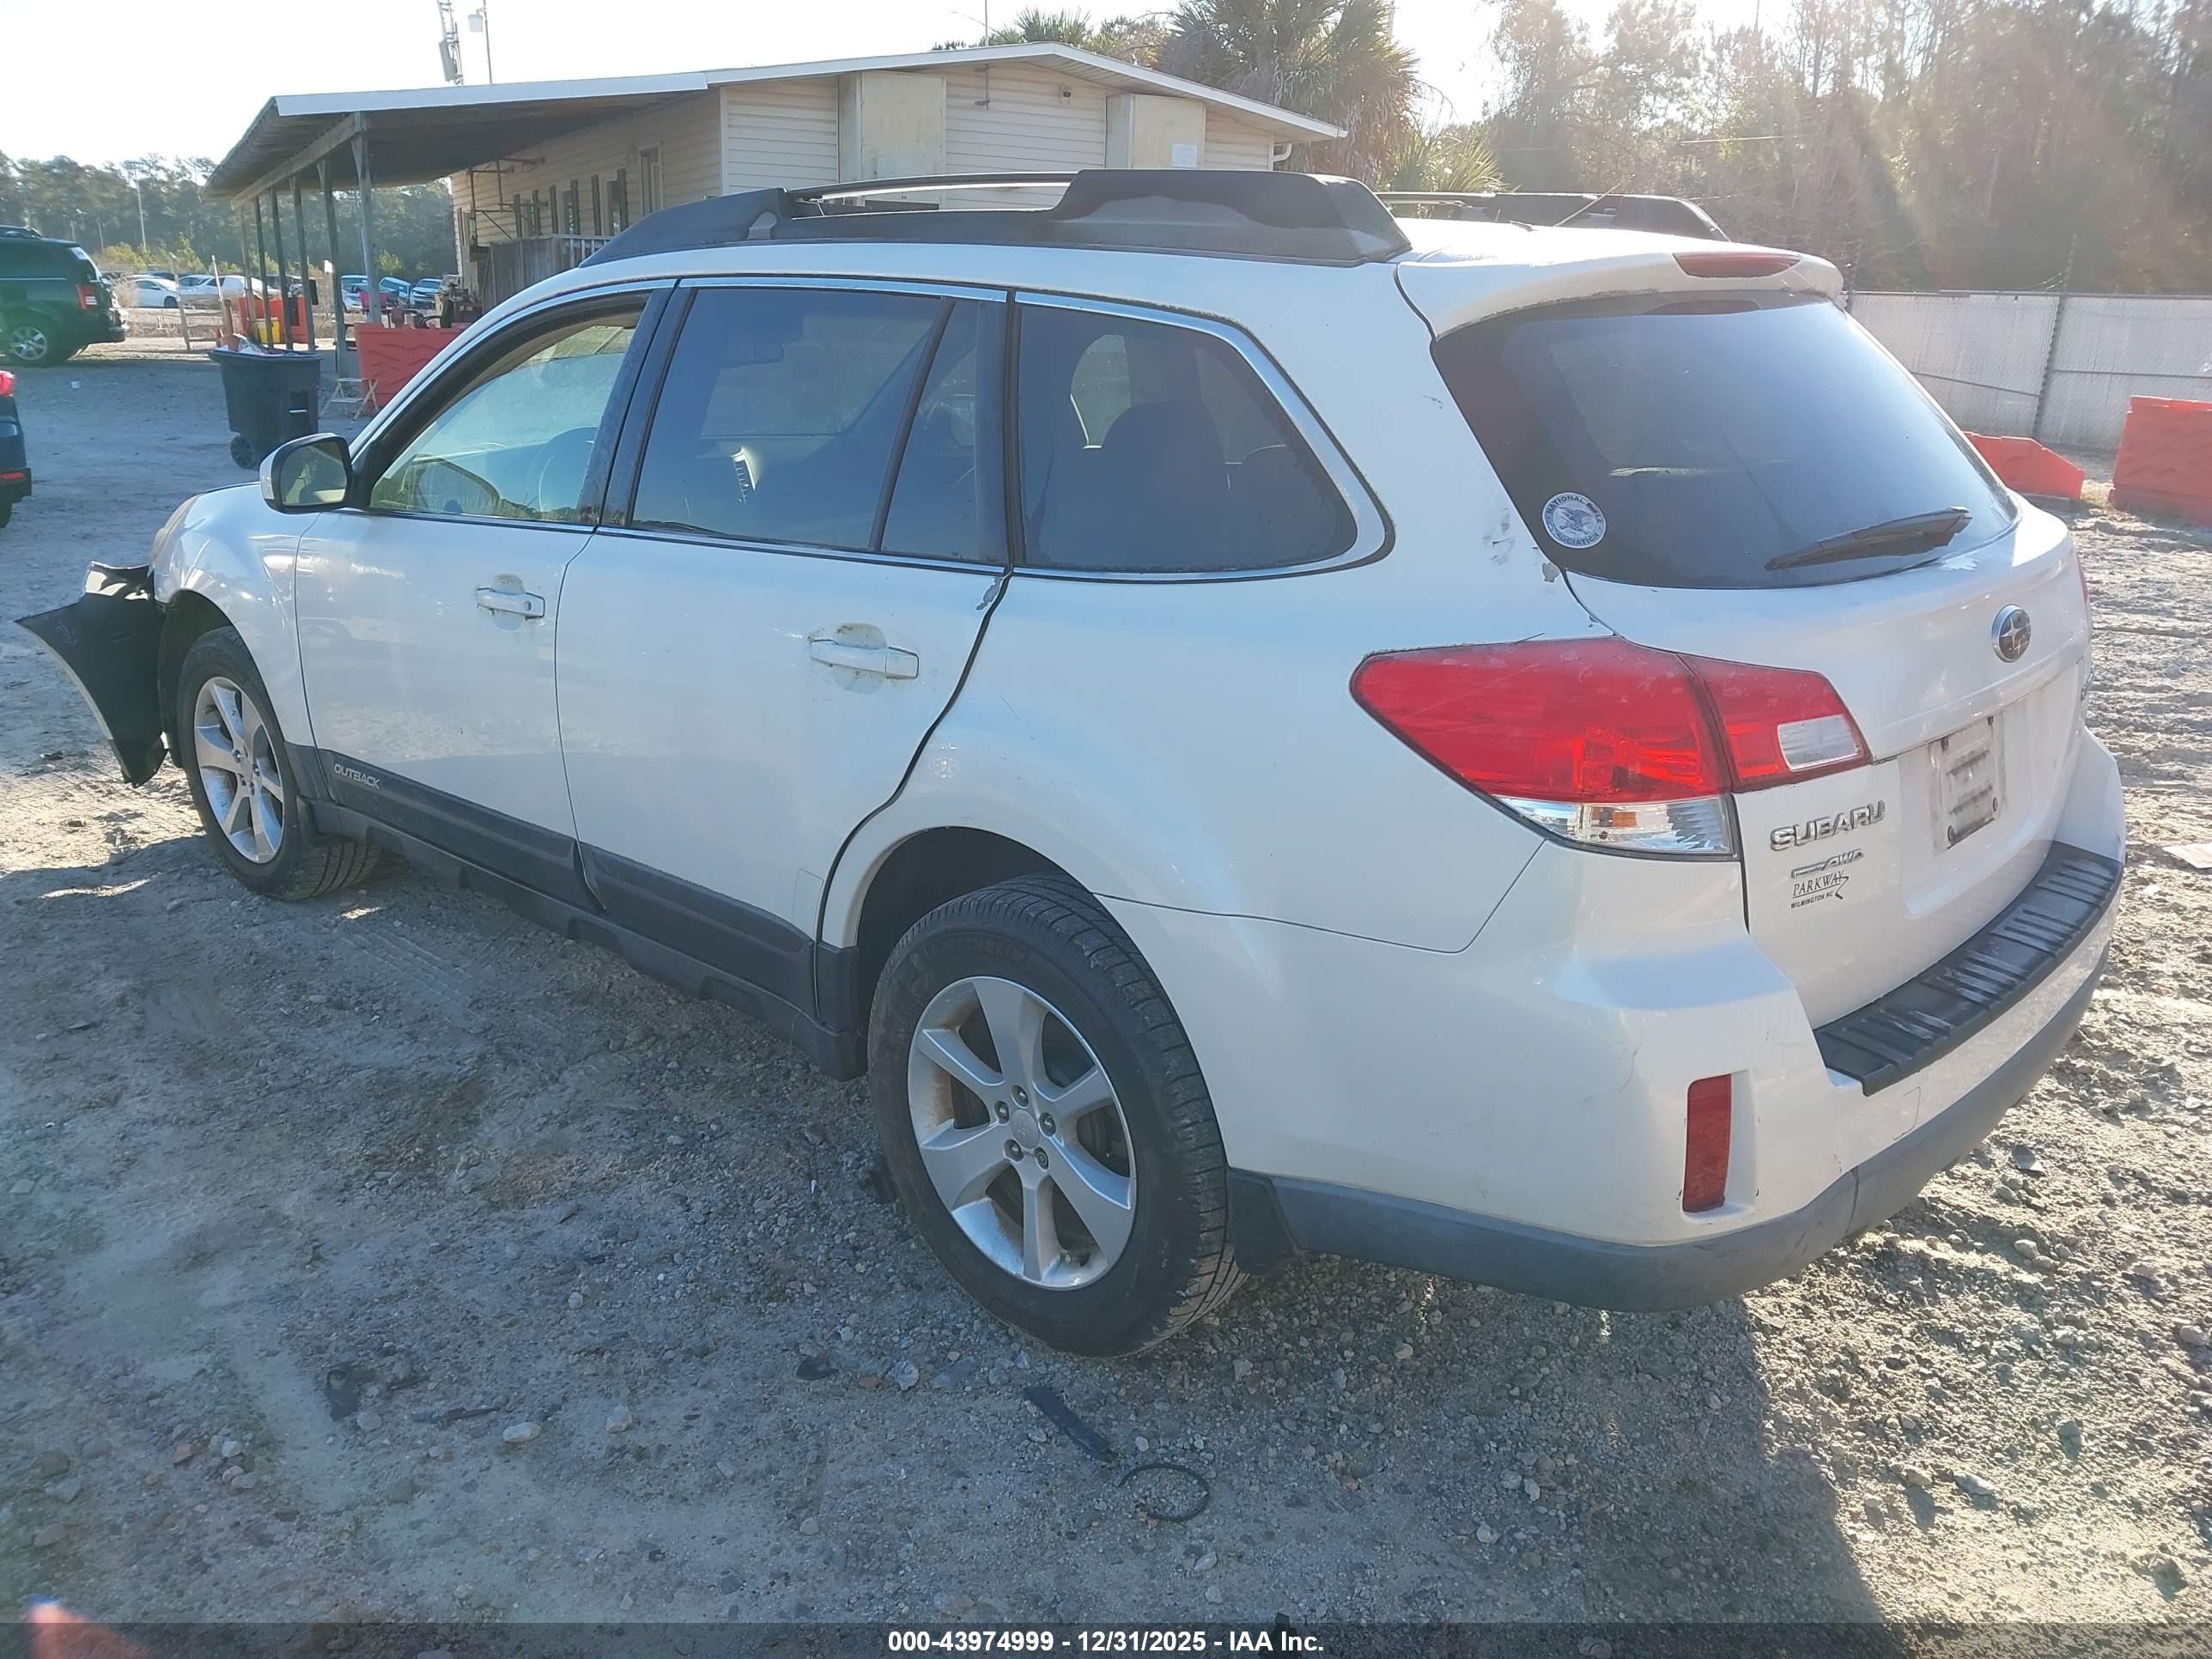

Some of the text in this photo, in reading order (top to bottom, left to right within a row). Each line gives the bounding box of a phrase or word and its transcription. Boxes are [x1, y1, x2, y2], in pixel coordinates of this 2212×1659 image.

[1547, 495, 1585, 514] NATIONAL
[1547, 522, 1600, 546] OCIATION
[334, 763, 380, 790] OUTBACK
[1771, 799, 1886, 851] SUBARU
[1792, 870, 1845, 896] PARKWAY
[1790, 890, 1834, 909] WILMINGTON NC
